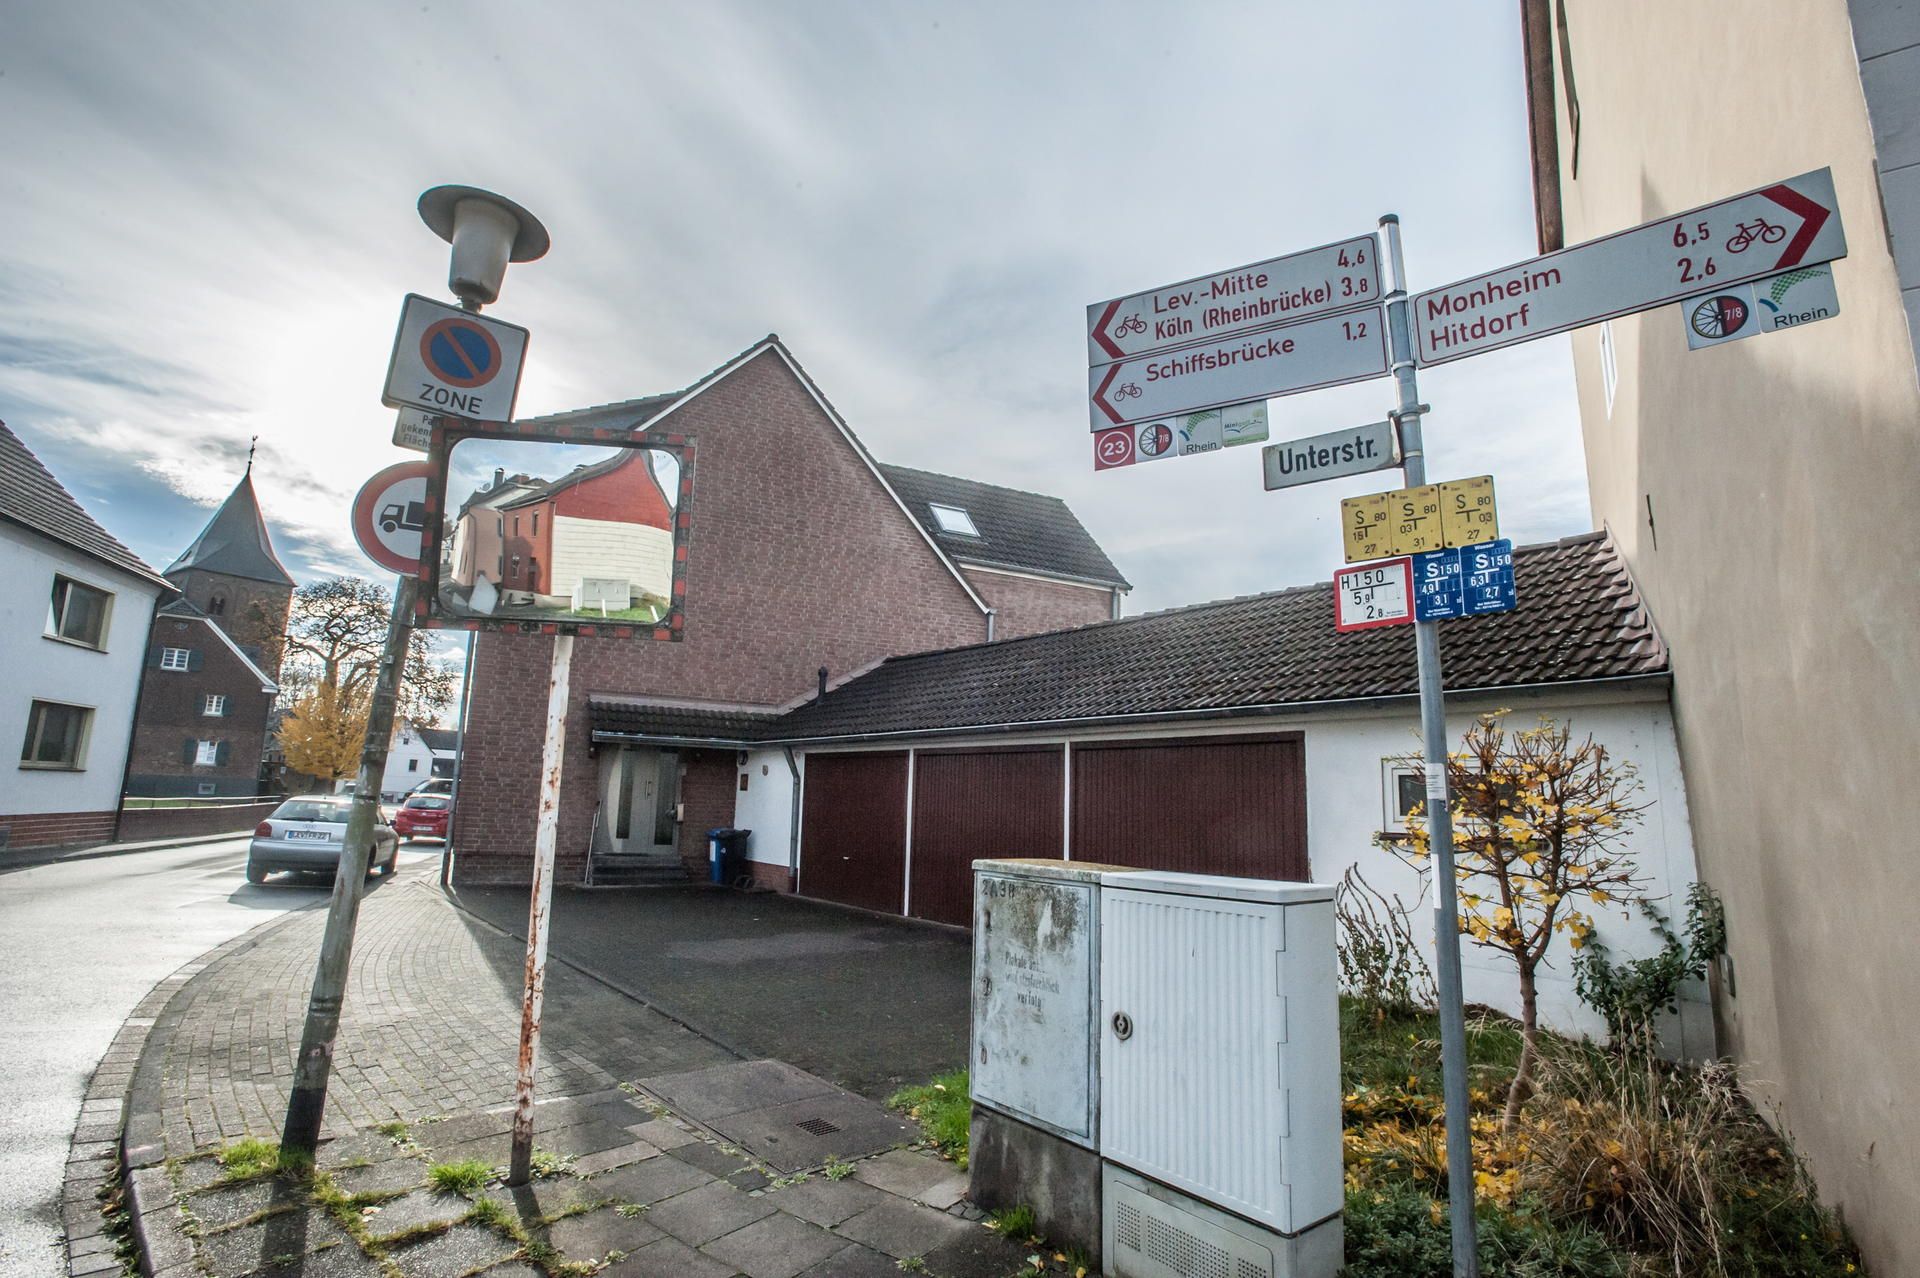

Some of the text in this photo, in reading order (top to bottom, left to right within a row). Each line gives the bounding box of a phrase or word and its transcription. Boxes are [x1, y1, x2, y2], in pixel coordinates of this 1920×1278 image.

[1673, 222, 1710, 248] 6,5
[1153, 249, 1366, 314] Lev.-Mitte 4,6
[1677, 256, 1716, 283] 2,6
[1155, 276, 1369, 340] Köln (Rheinbrücke) 3,8
[1427, 268, 1561, 321] Monheim
[1430, 303, 1530, 351] Hitdorf
[1724, 307, 1743, 321] 7/8
[1773, 306, 1829, 328] Rhein
[1146, 321, 1368, 382] Schiffsbrücke 1,2
[419, 383, 483, 415] ZONE
[1103, 440, 1126, 457] 23
[1158, 433, 1170, 444] 7/8
[1186, 441, 1217, 454] Rhein
[1279, 435, 1379, 475] Unterstr.
